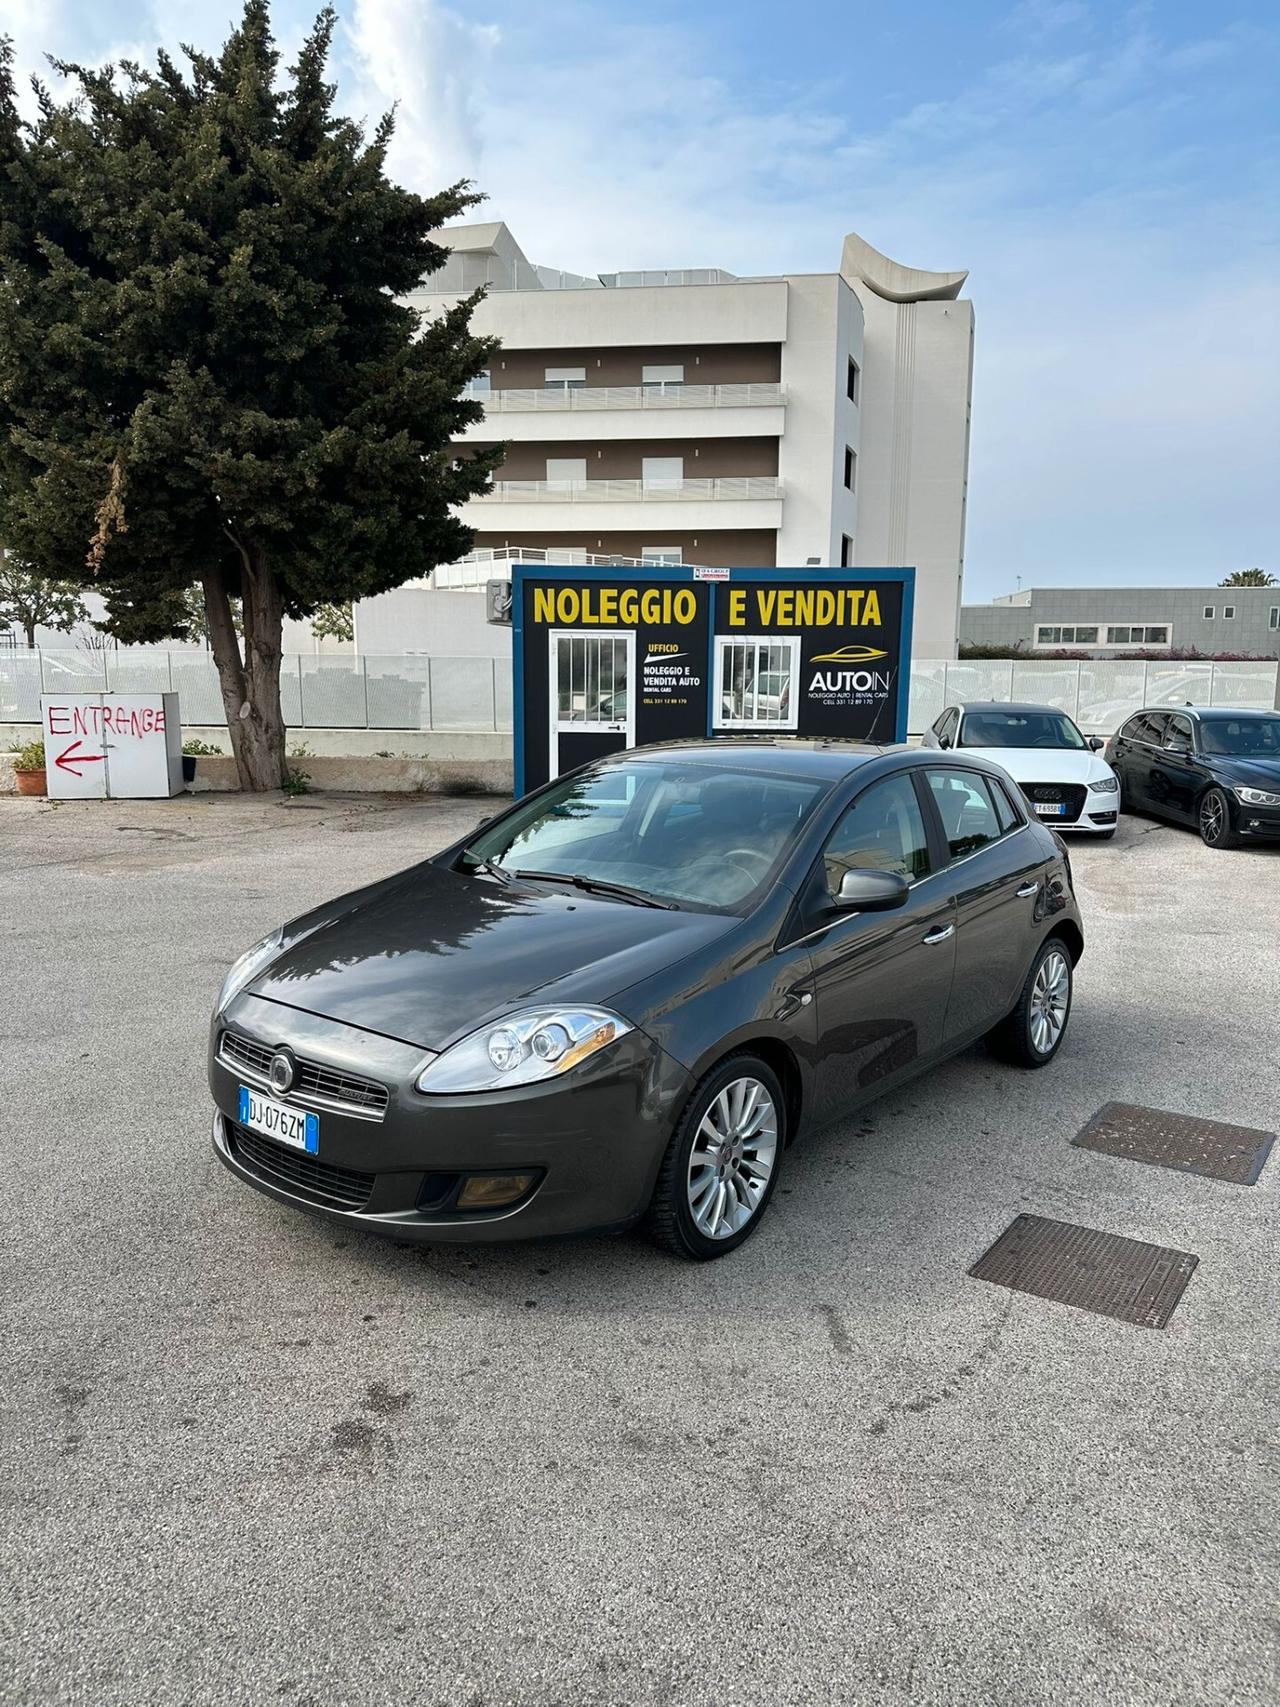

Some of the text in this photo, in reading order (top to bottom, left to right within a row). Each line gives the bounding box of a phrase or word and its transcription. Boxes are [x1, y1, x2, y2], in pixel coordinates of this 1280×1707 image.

[534, 588, 882, 626] NOLEGGIO E VENDITA
[648, 644, 679, 652] UFFICIO
[644, 666, 690, 675] NOLEGGIO E
[643, 677, 700, 686] VENDITA AUTO
